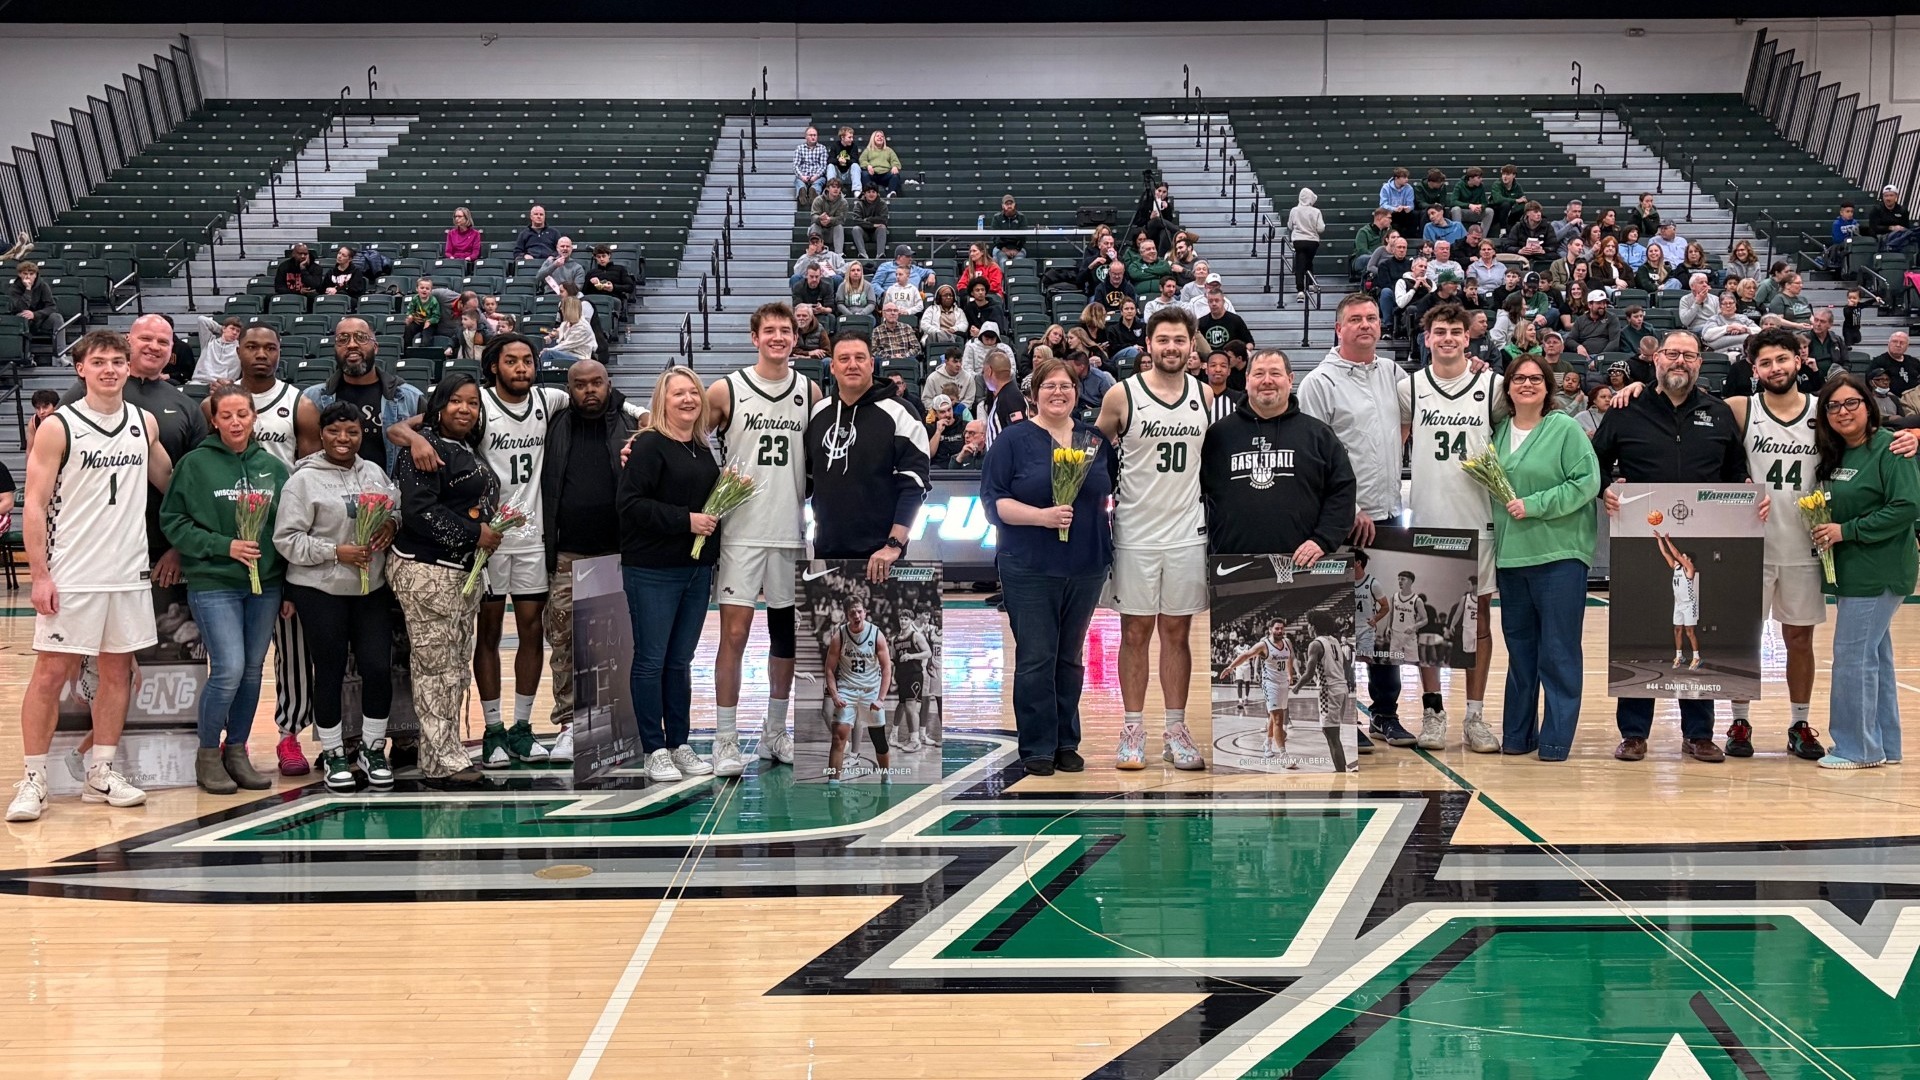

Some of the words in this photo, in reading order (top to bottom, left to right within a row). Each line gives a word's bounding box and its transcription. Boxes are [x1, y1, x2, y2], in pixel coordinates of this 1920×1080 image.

[894, 292, 911, 301] USA
[743, 412, 803, 432] Warriors
[1420, 408, 1483, 426] Warriors
[254, 427, 287, 443] iors
[1139, 420, 1202, 439] Warriors
[489, 432, 544, 451] Warriors
[757, 434, 789, 467] 23
[1434, 430, 1468, 461] 34
[1751, 435, 1819, 455] Warriors
[80, 449, 144, 471] Warriors
[1156, 441, 1188, 473] 30
[1231, 452, 1295, 472] BASKETBALL
[510, 453, 533, 485] 13
[1252, 467, 1273, 475] NACC
[1766, 459, 1802, 491] 44
[108, 472, 117, 505] 1
[1697, 490, 1756, 501] WARRIORS
[1415, 535, 1470, 546] WARRIORS
[1400, 612, 1405, 622] 3
[1369, 650, 1405, 659] LUBBERS
[851, 660, 866, 673] 23
[1276, 660, 1286, 672] 30
[139, 674, 197, 711] SNC
[1665, 683, 1689, 691] DANIEL
[1690, 684, 1721, 692] FRAUSTO
[1260, 757, 1297, 766] EPHRAIM
[1297, 756, 1331, 765] ALBERS
[822, 767, 837, 775] #23
[843, 767, 873, 775] AUSTIN
[875, 767, 911, 775] WAGNER
